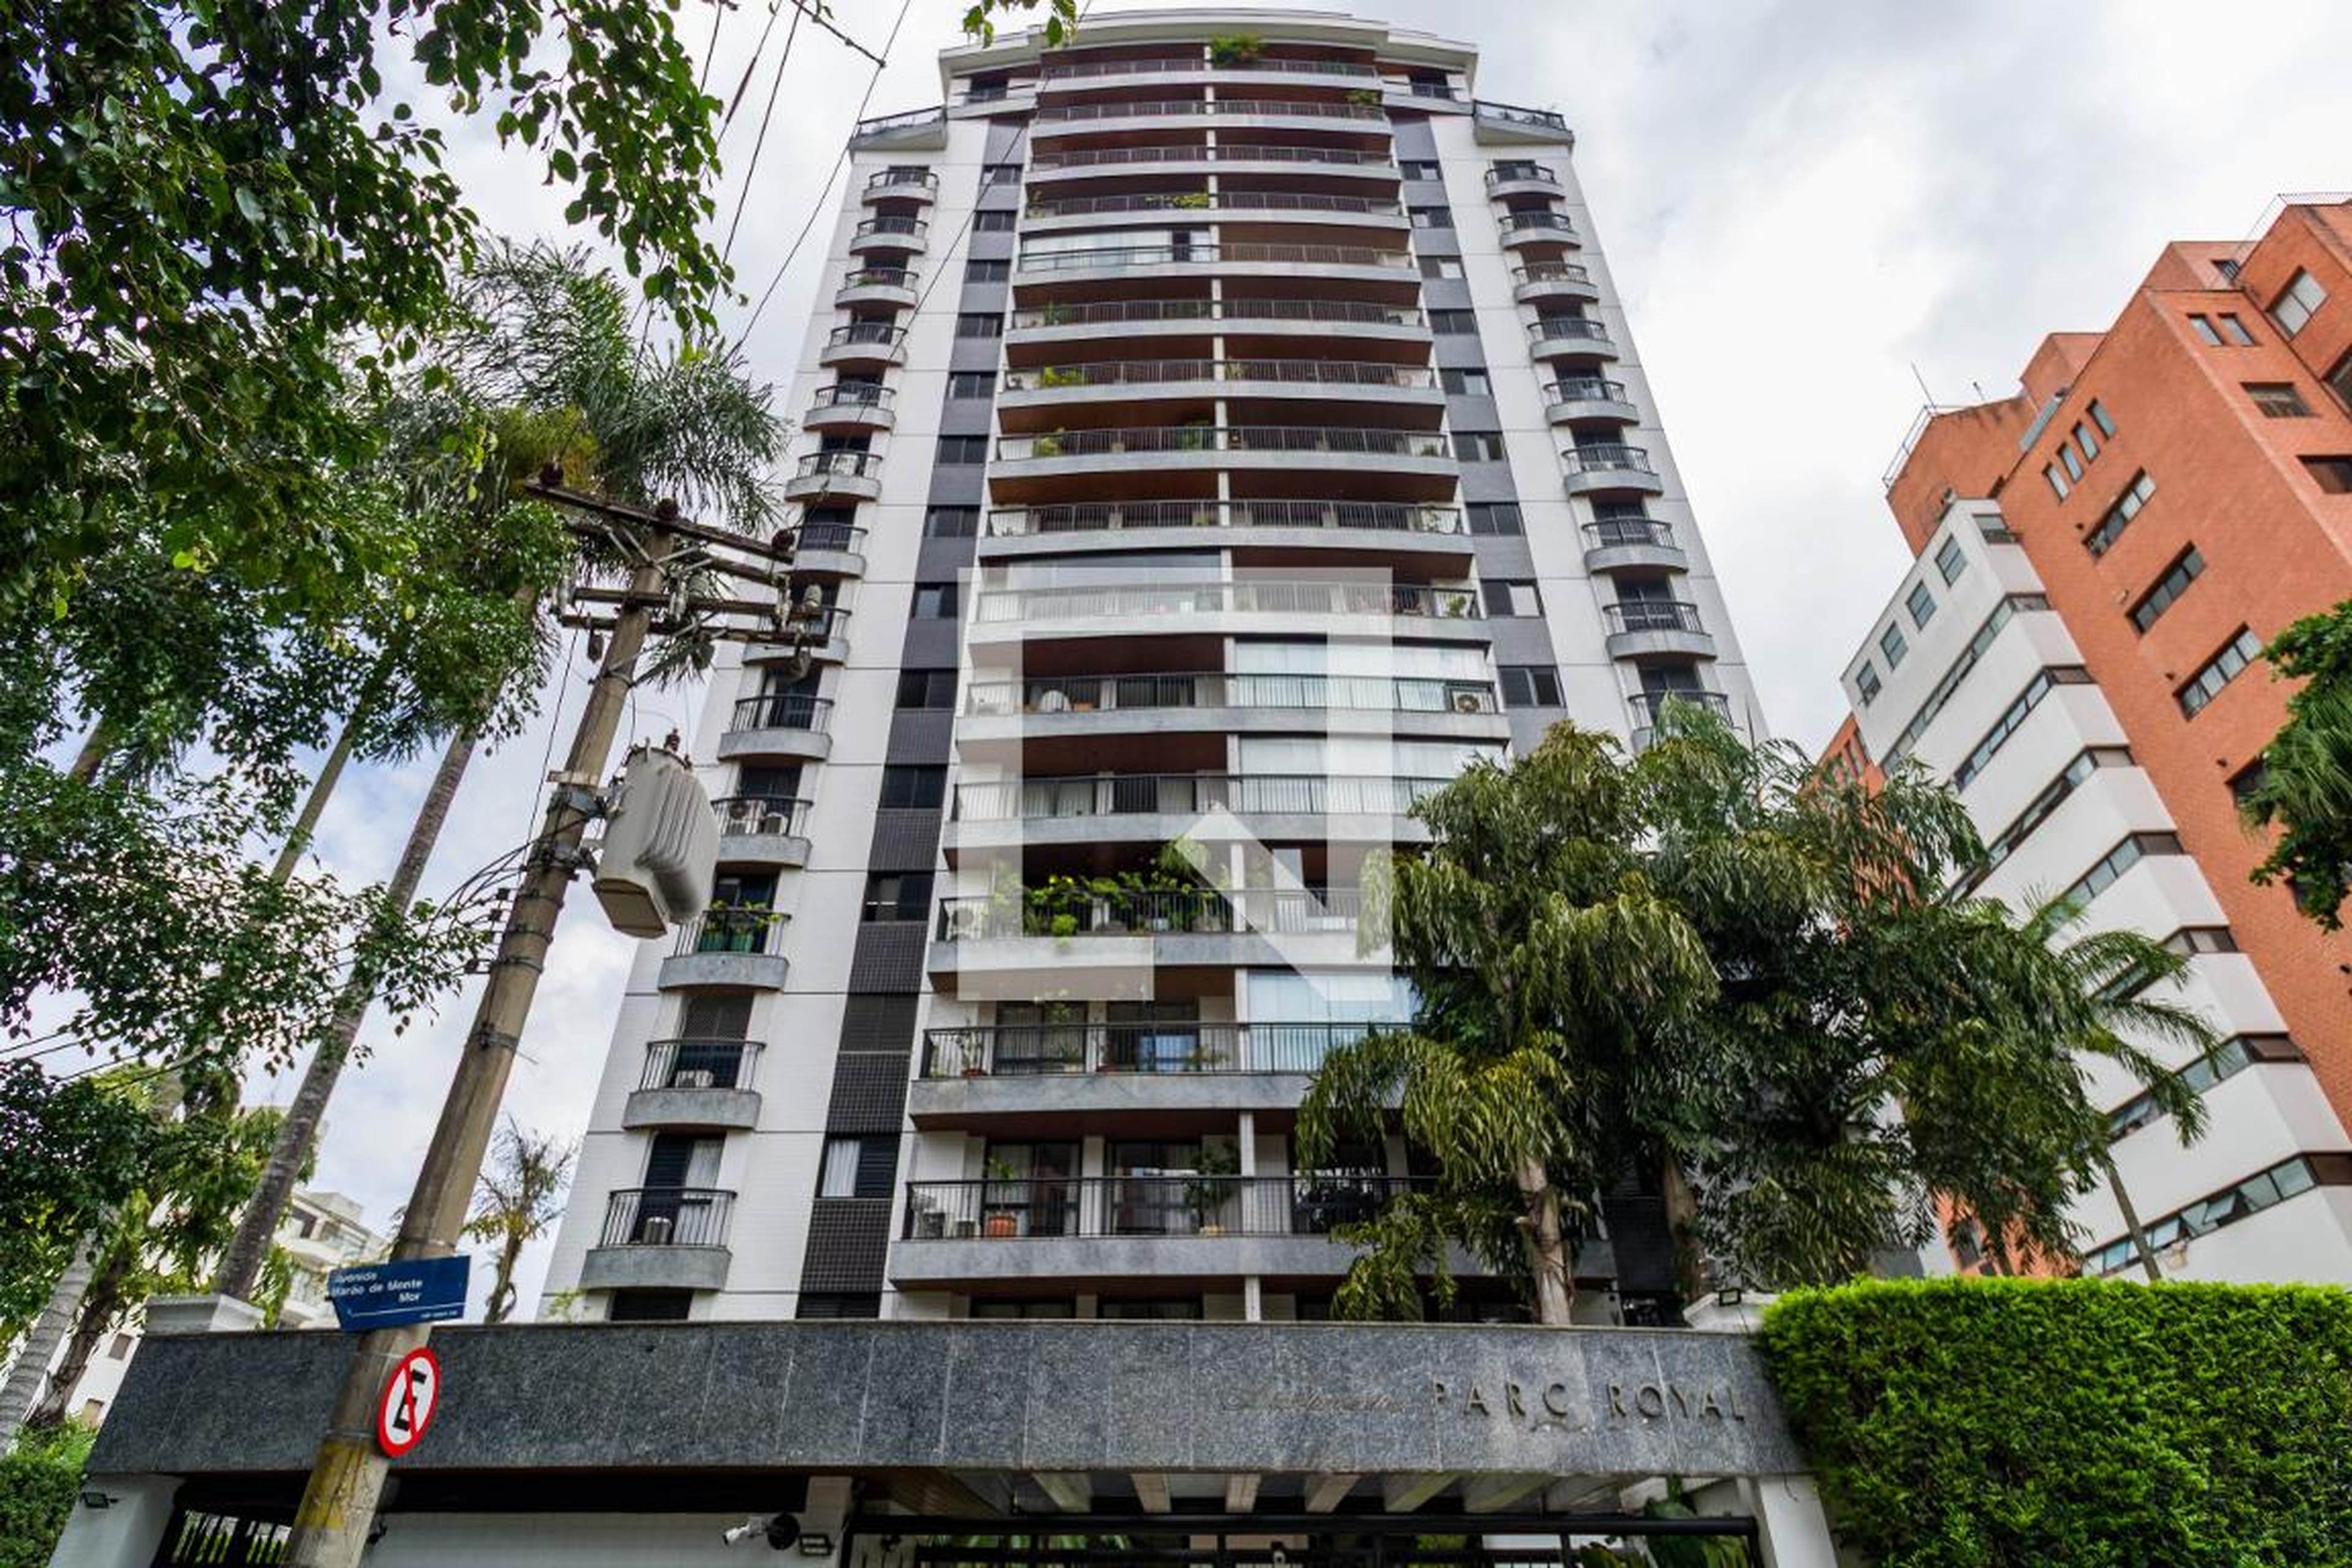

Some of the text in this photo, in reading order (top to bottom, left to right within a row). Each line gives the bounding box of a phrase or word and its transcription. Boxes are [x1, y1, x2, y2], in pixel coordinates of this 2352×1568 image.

[369, 1283, 384, 1294] de
[387, 1278, 424, 1291] Monte
[398, 1291, 423, 1303] Mor
[1432, 1381, 1569, 1418] PARC
[1607, 1381, 1745, 1422] ROYAL
